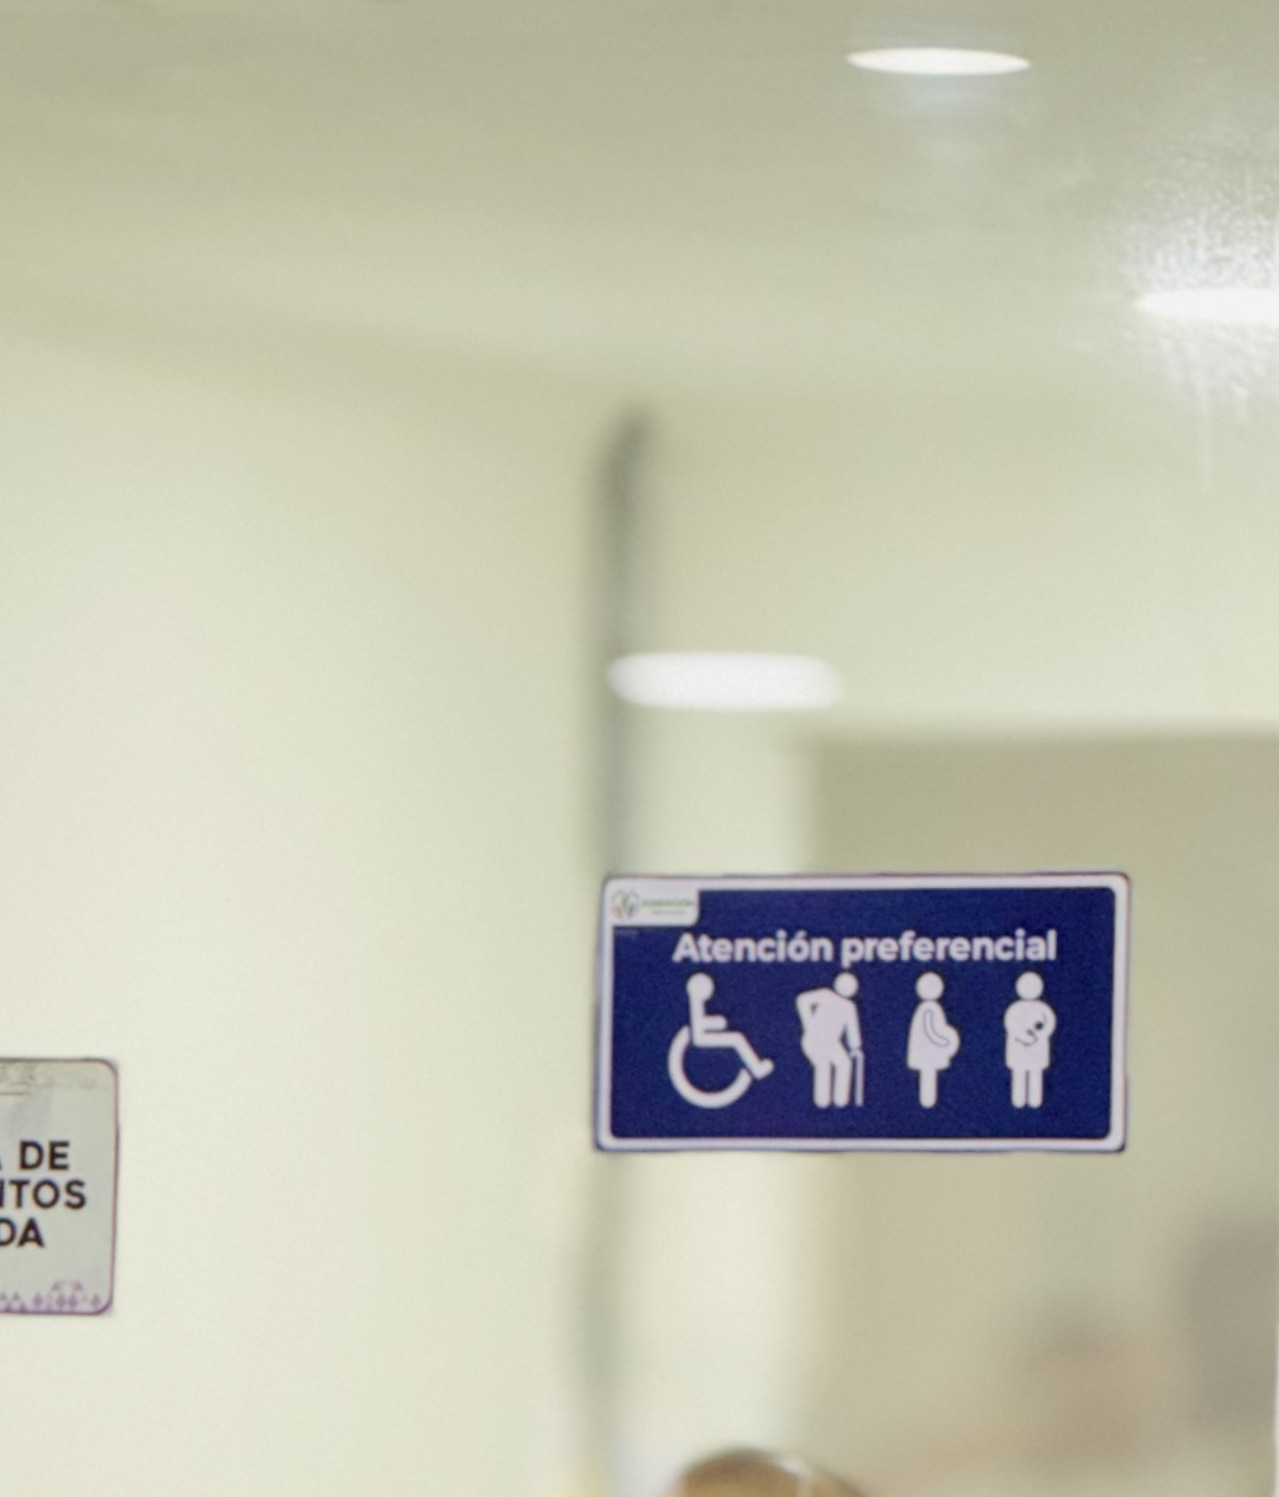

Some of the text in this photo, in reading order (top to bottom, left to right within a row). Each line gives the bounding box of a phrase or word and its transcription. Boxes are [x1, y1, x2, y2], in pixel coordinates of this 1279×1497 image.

[672, 928, 1058, 968] Atención preferencial
[19, 1140, 70, 1170] DE
